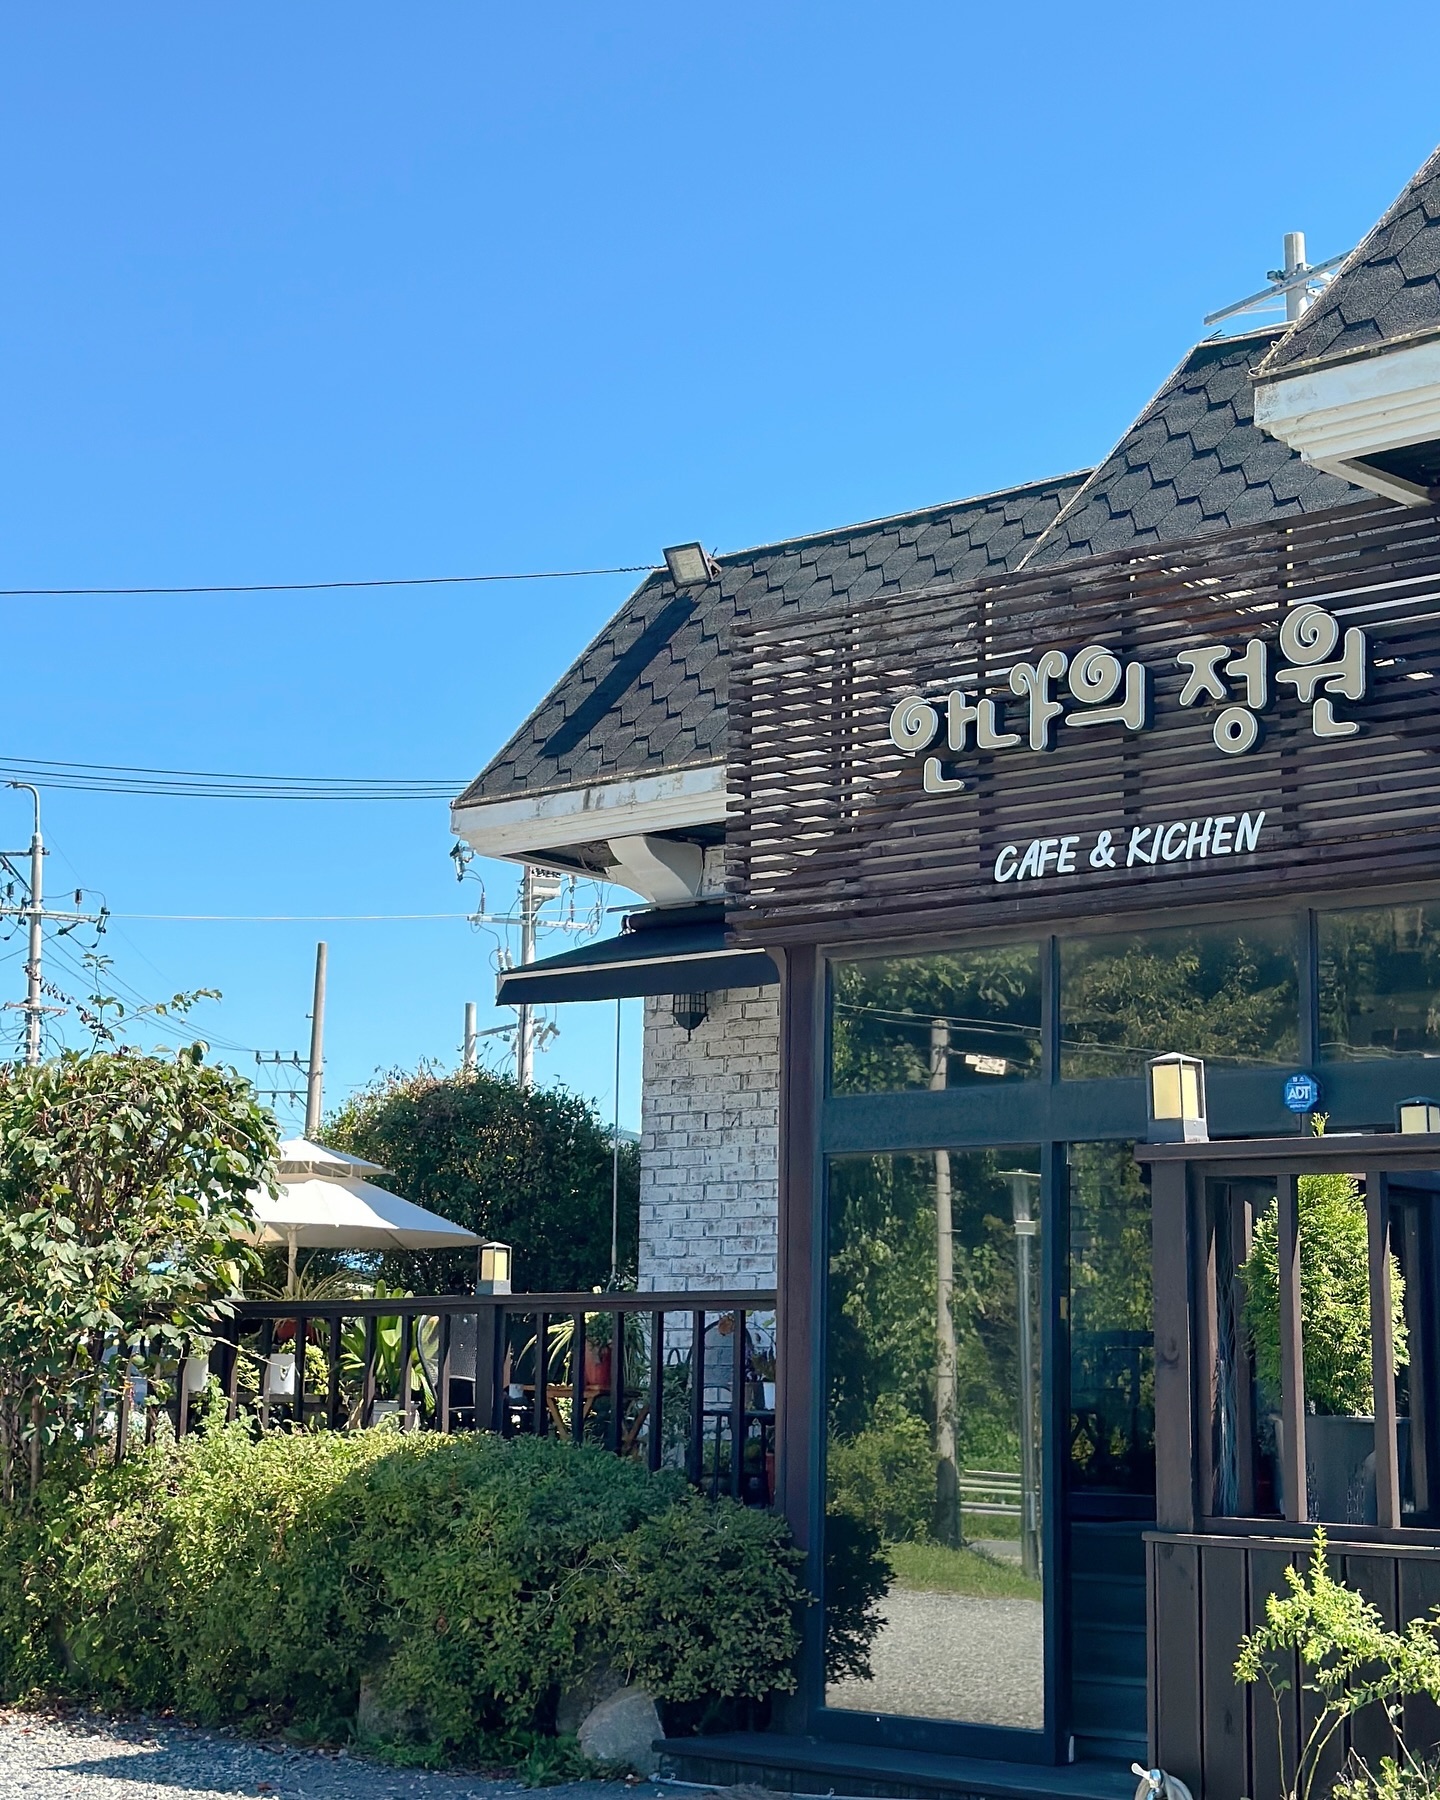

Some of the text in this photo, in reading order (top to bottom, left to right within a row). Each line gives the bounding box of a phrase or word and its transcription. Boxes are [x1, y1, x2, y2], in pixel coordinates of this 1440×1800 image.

[889, 605, 1366, 793] 안나의 정원
[994, 812, 1265, 882] CAFE & KICHEN
[1287, 1086, 1310, 1100] ADT
